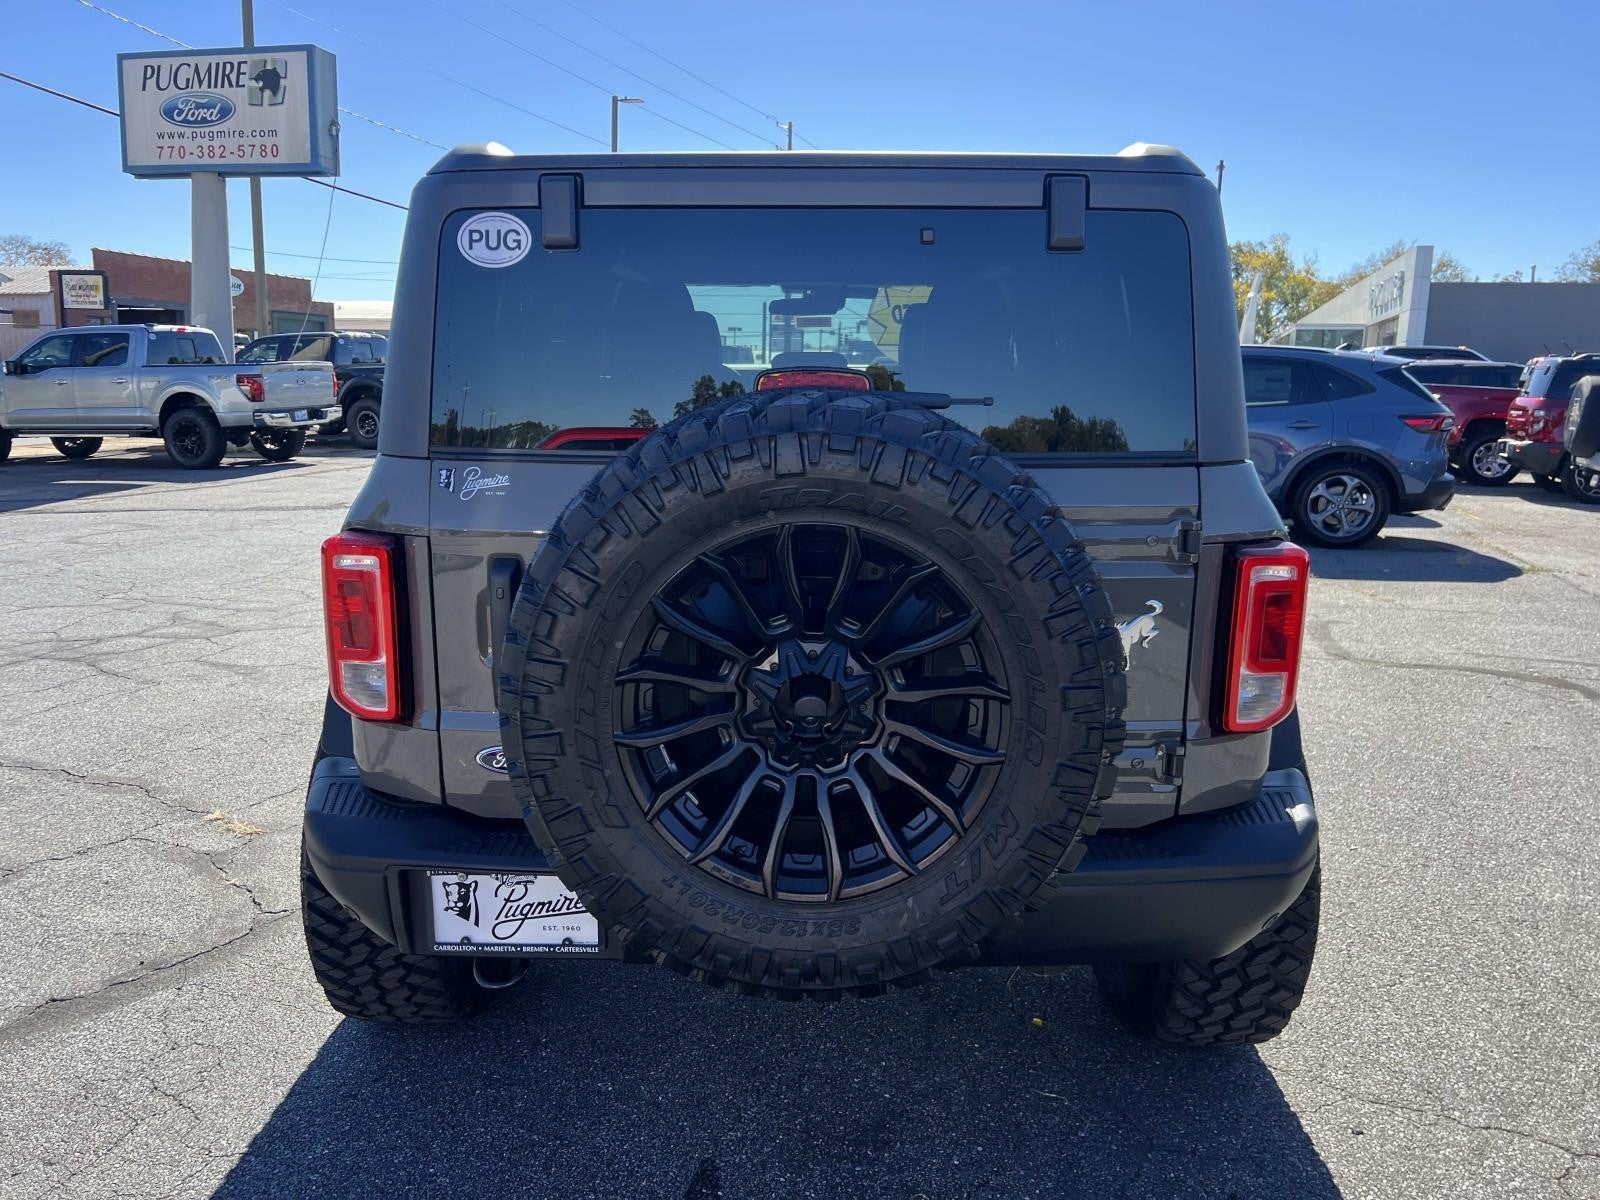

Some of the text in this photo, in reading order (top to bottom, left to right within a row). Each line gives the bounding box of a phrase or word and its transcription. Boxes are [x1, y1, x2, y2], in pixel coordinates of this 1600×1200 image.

[141, 60, 248, 92] PUGMIRE
[173, 97, 222, 122] Ford
[156, 128, 278, 142] www.pugmire.com
[156, 143, 279, 160] 770-382-5780
[468, 229, 522, 251] PUG
[460, 466, 510, 501] Pugmire
[759, 484, 912, 526] TRAIL
[931, 527, 1048, 767] GRAPPLER
[491, 878, 588, 940] Pugmire
[433, 944, 477, 953] CARROLLTON
[484, 945, 516, 953] MARIETTA
[555, 946, 600, 954] CARTERSVILLE
